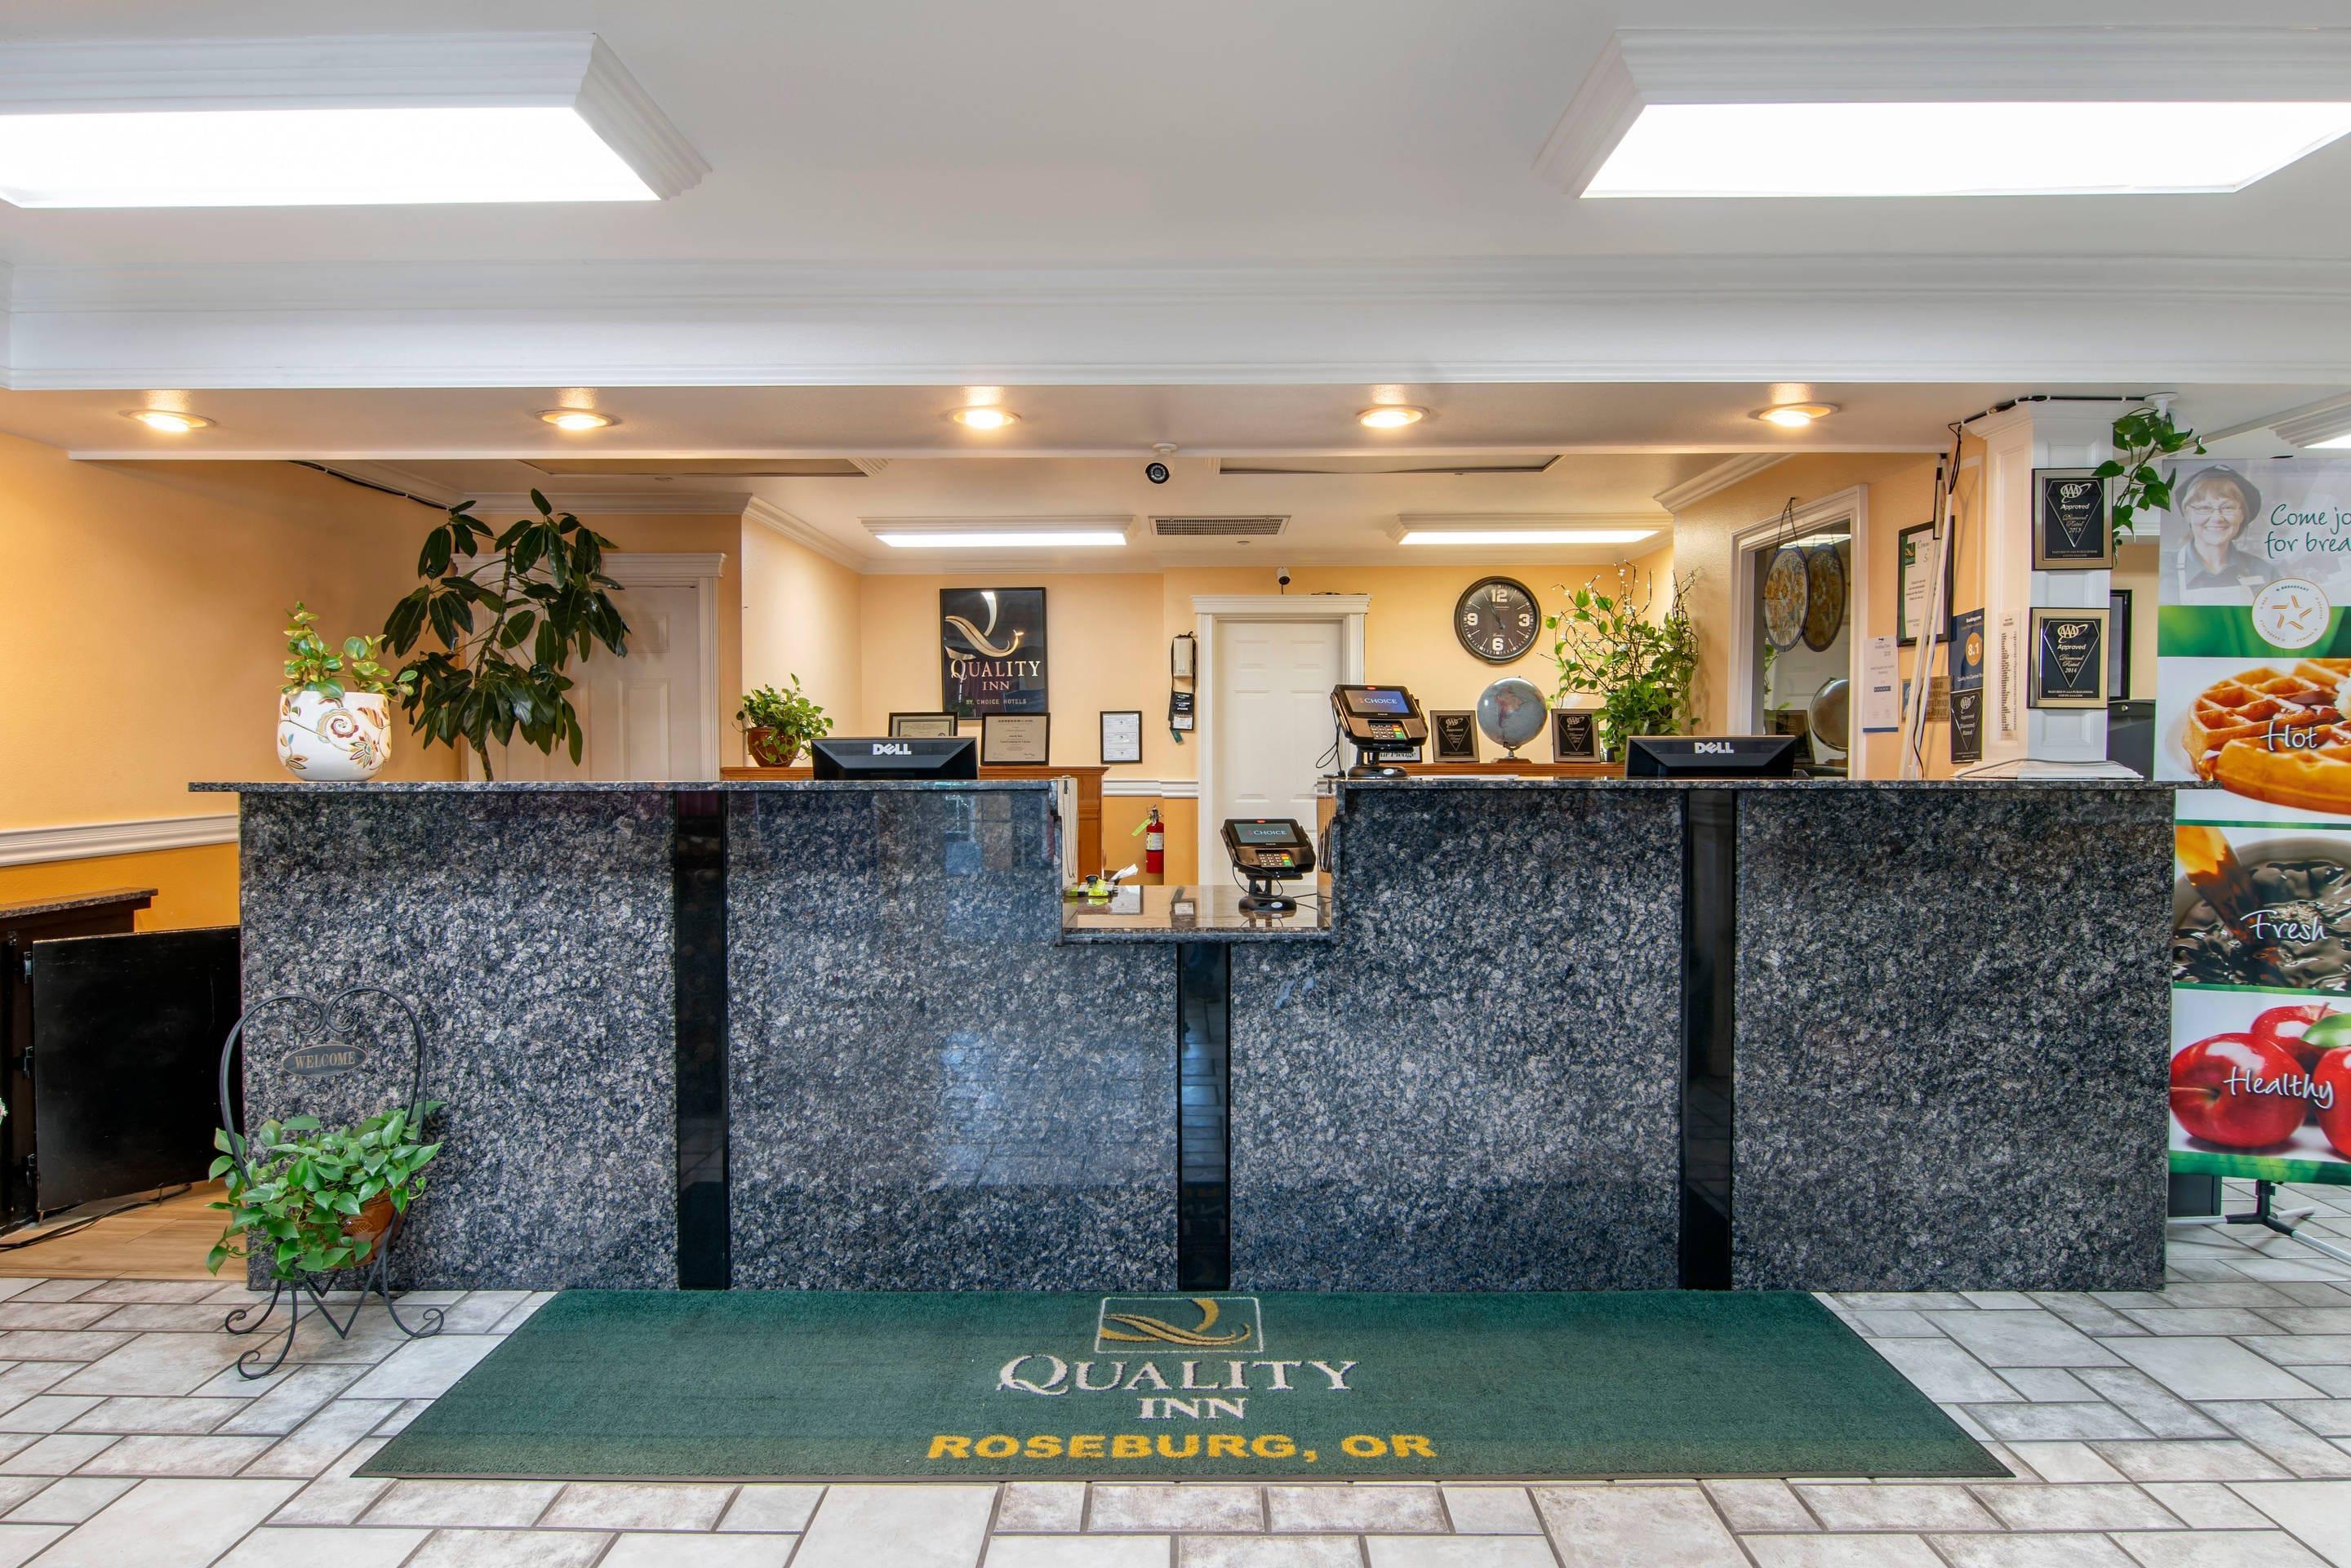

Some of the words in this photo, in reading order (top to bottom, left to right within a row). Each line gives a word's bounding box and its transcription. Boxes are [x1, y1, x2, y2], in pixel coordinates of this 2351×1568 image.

[2061, 484, 2081, 497] AAA
[2270, 504, 2327, 526] Come
[2264, 531, 2298, 559] for
[1491, 589, 1508, 602] 12
[1467, 613, 1478, 626] 9
[1518, 614, 1530, 627] 3
[2059, 624, 2078, 638] AAA
[1492, 637, 1504, 651] 6
[1967, 642, 1980, 656] 8.1
[951, 659, 1041, 680] QUALITY
[982, 681, 1010, 691] INN
[2259, 721, 2318, 752] Hot
[873, 743, 912, 755] DELL
[1694, 742, 1735, 754] DELL
[2240, 909, 2328, 942] Fresh
[295, 1051, 356, 1070] WELCOME
[2222, 1065, 2334, 1109] Healthy
[995, 1354, 1360, 1396] QUALITY
[1137, 1397, 1247, 1419] INN
[927, 1433, 1318, 1463] ROSEBURG,
[1340, 1433, 1438, 1459] OR
